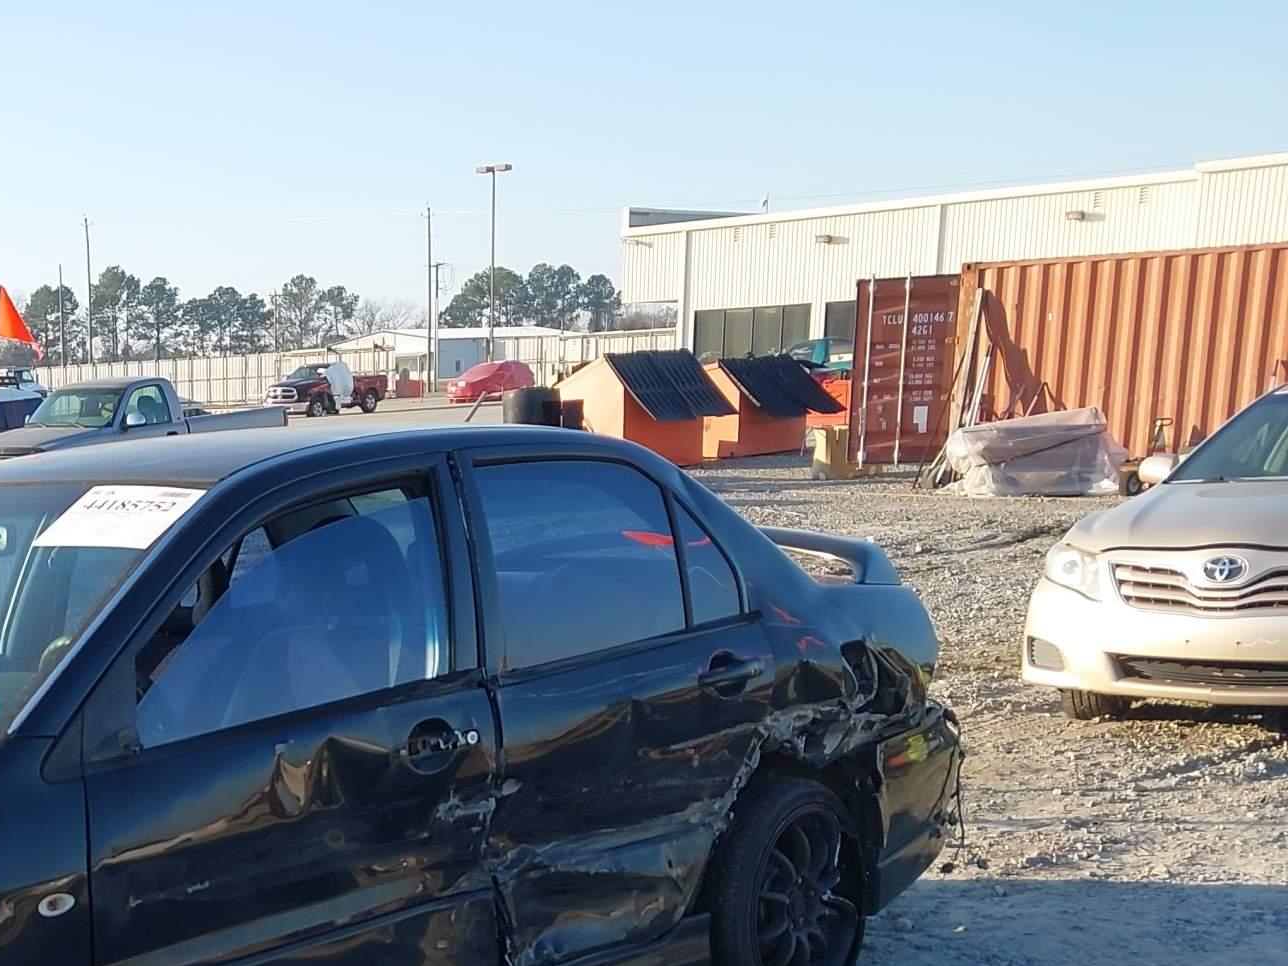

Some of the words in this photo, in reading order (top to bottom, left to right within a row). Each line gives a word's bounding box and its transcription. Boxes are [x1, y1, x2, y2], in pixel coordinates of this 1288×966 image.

[882, 314, 904, 325] TCLU
[912, 312, 945, 323] 400146
[82, 499, 177, 511] 44185752
